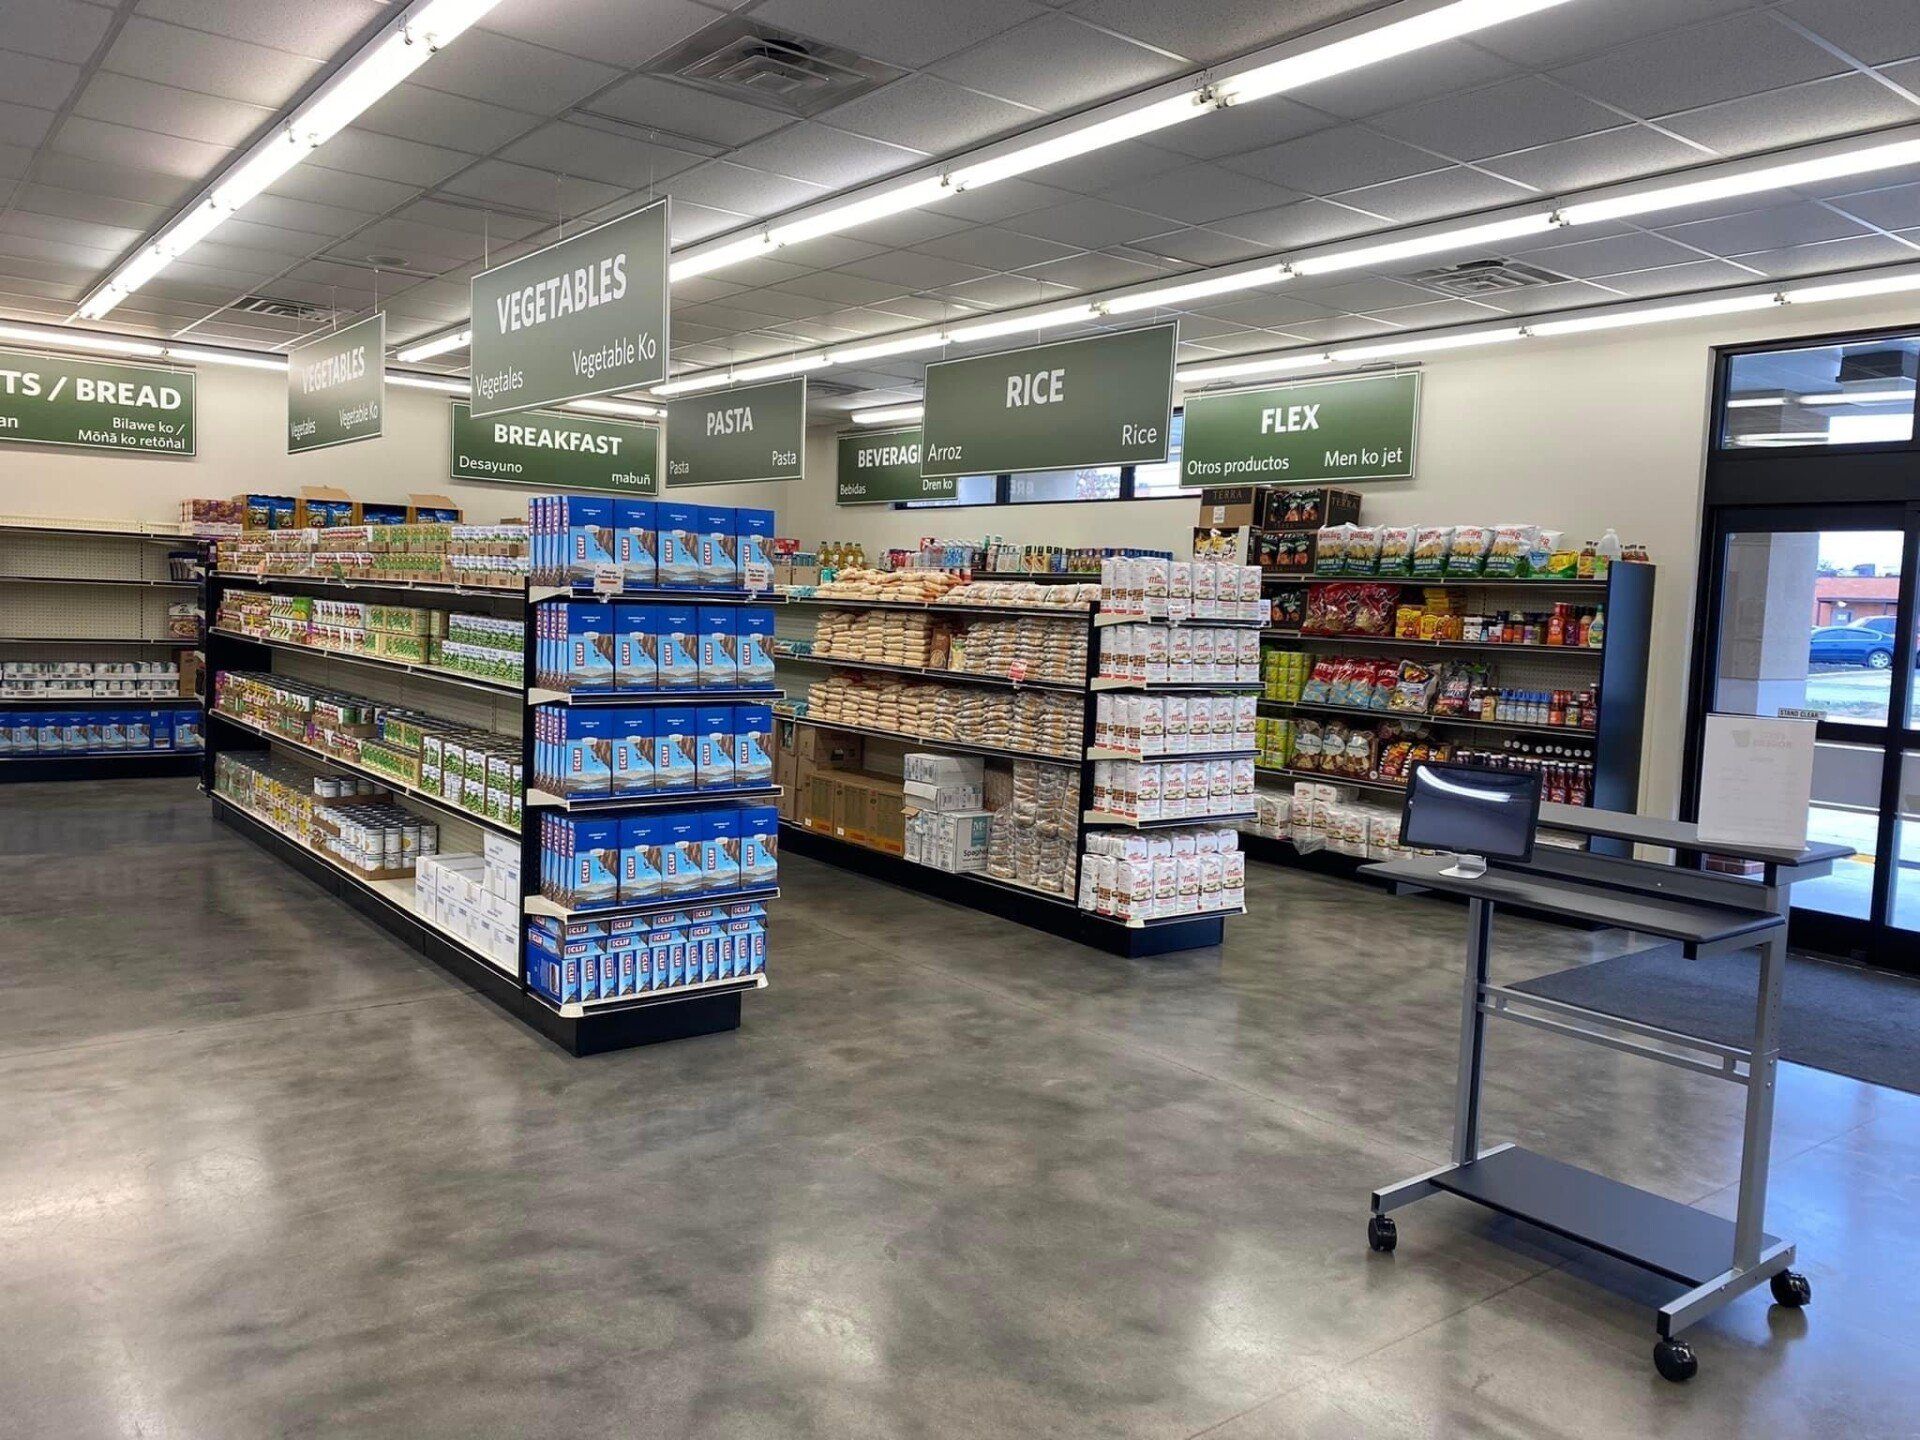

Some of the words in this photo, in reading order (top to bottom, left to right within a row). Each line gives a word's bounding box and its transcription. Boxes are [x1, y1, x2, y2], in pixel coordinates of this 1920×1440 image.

[496, 253, 627, 335] VEGETABLES
[573, 340, 635, 378] Vegetable
[638, 332, 656, 361] Ko
[302, 346, 366, 395] VEGETABLES
[475, 366, 524, 399] Vegetales
[76, 378, 182, 410] BREAD
[1005, 368, 1065, 409] RICE
[112, 417, 155, 432] Bilawe
[158, 421, 174, 433] ko
[706, 405, 754, 436] PASTA
[1260, 403, 1319, 435] FLEX
[121, 433, 136, 445] ko
[494, 423, 623, 455] BREAKFAST
[1121, 423, 1157, 447] Rice
[459, 455, 523, 473] Desayuno
[771, 448, 797, 466] Pasta
[927, 443, 962, 462] Arroz
[1324, 449, 1358, 467] Men
[1361, 448, 1378, 465] ko
[1379, 446, 1403, 470] jet
[669, 460, 689, 476] Pasta
[1187, 457, 1221, 476] Otros
[1223, 454, 1290, 476] productos
[840, 483, 867, 496] Bebidas
[922, 479, 942, 491] Dren
[943, 478, 953, 490] ko
